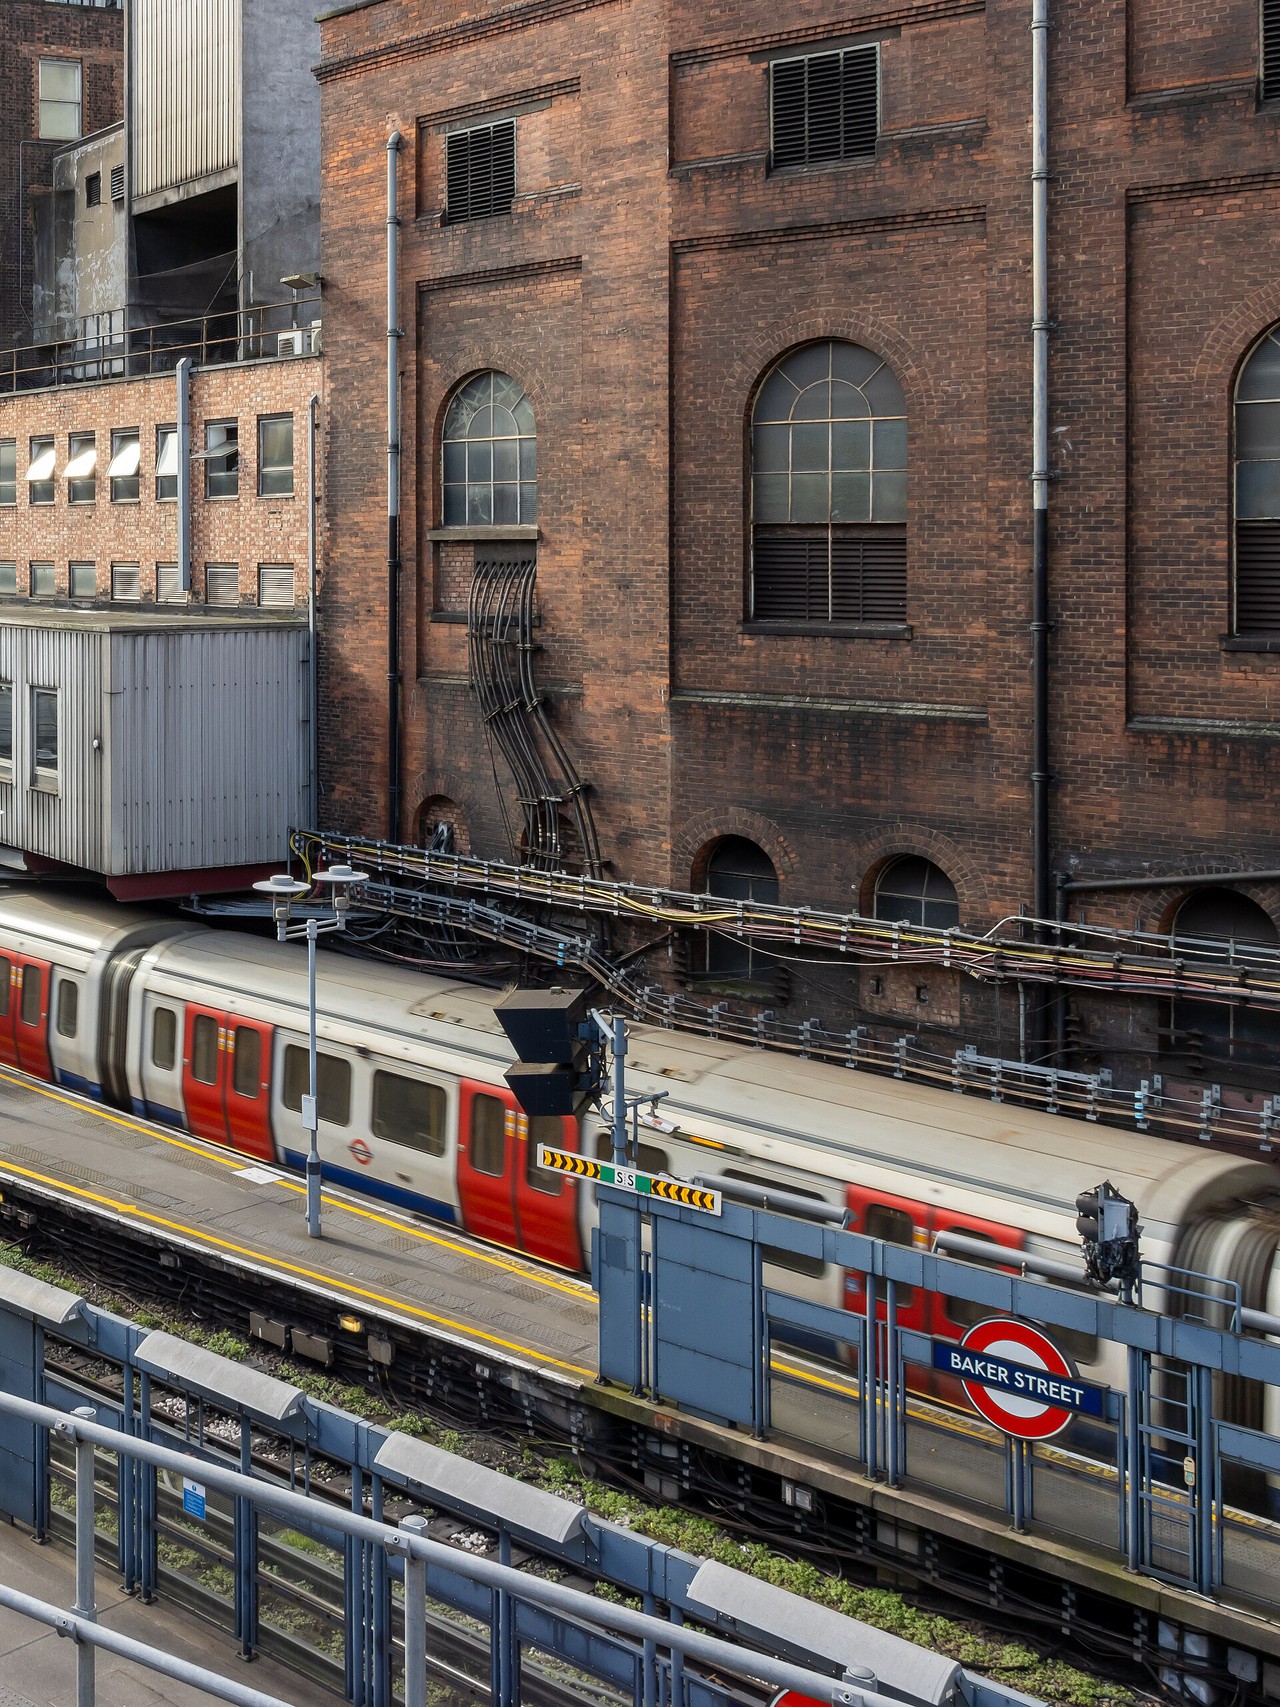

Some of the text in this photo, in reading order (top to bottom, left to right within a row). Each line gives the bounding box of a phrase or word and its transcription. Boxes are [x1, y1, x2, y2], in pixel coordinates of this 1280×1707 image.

[950, 1352, 1084, 1406] BAKER STREET
[919, 1406, 973, 1428] MIND
